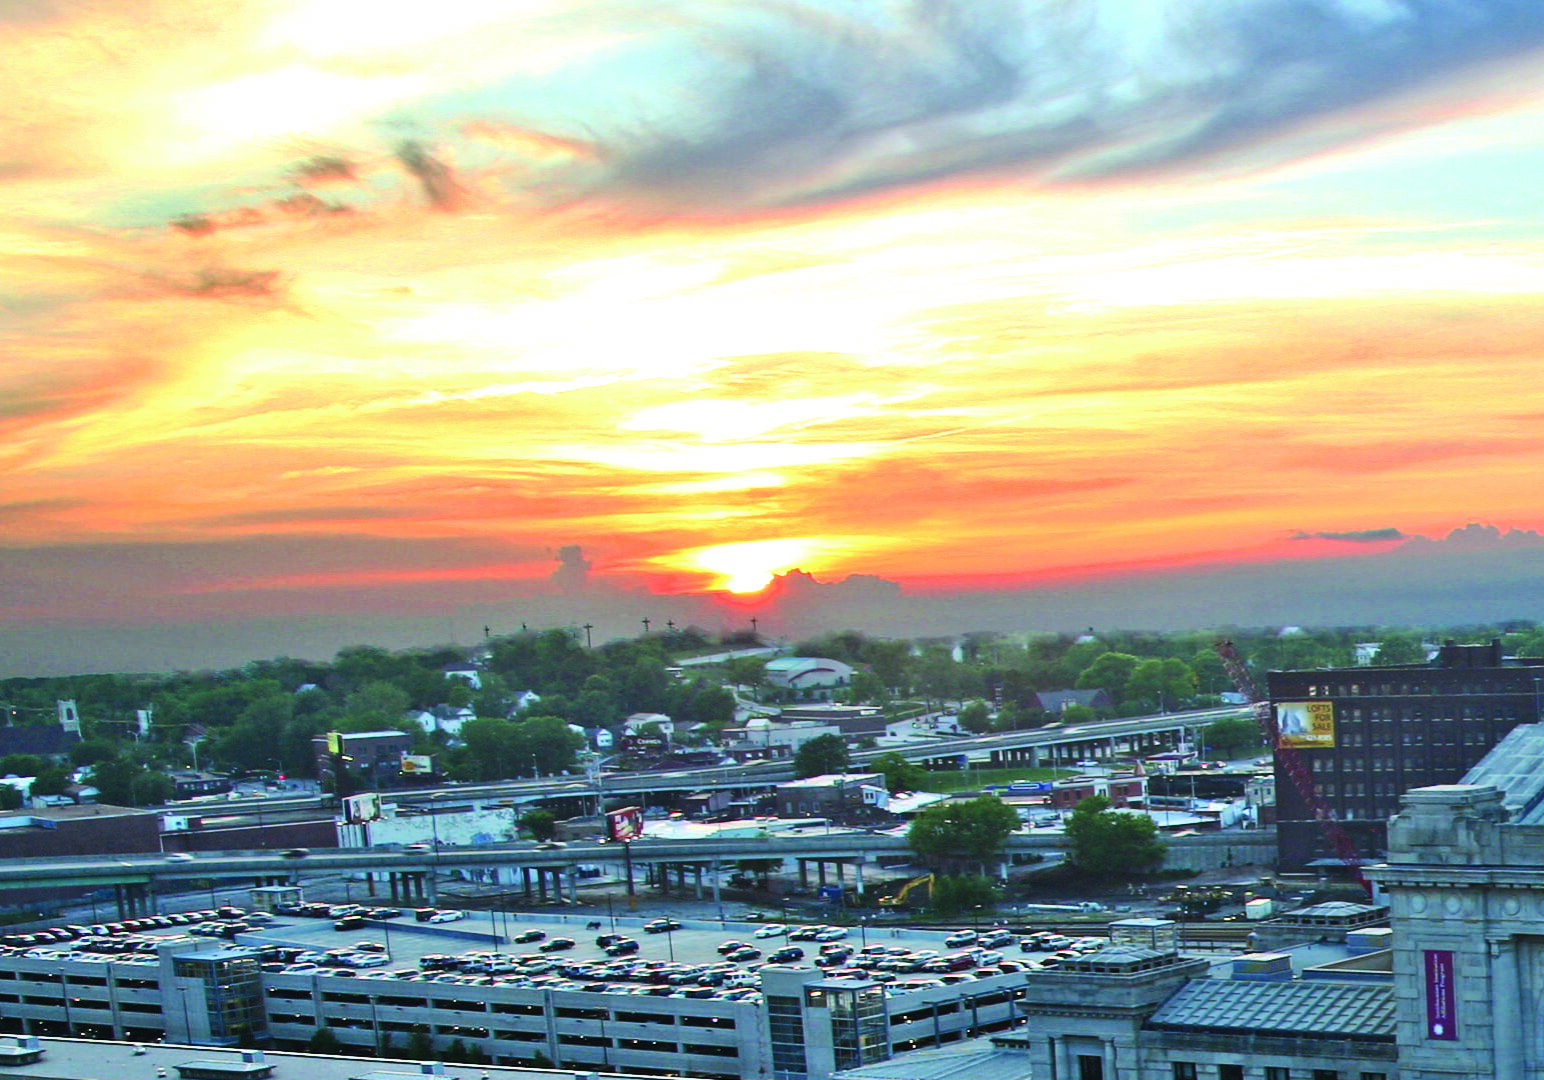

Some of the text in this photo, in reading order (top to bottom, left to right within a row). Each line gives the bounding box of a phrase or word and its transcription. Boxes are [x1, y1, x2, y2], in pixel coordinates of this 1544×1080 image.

[1307, 704, 1331, 713] LOFTS
[1314, 713, 1332, 721] FOR
[1312, 722, 1332, 731] SALE
